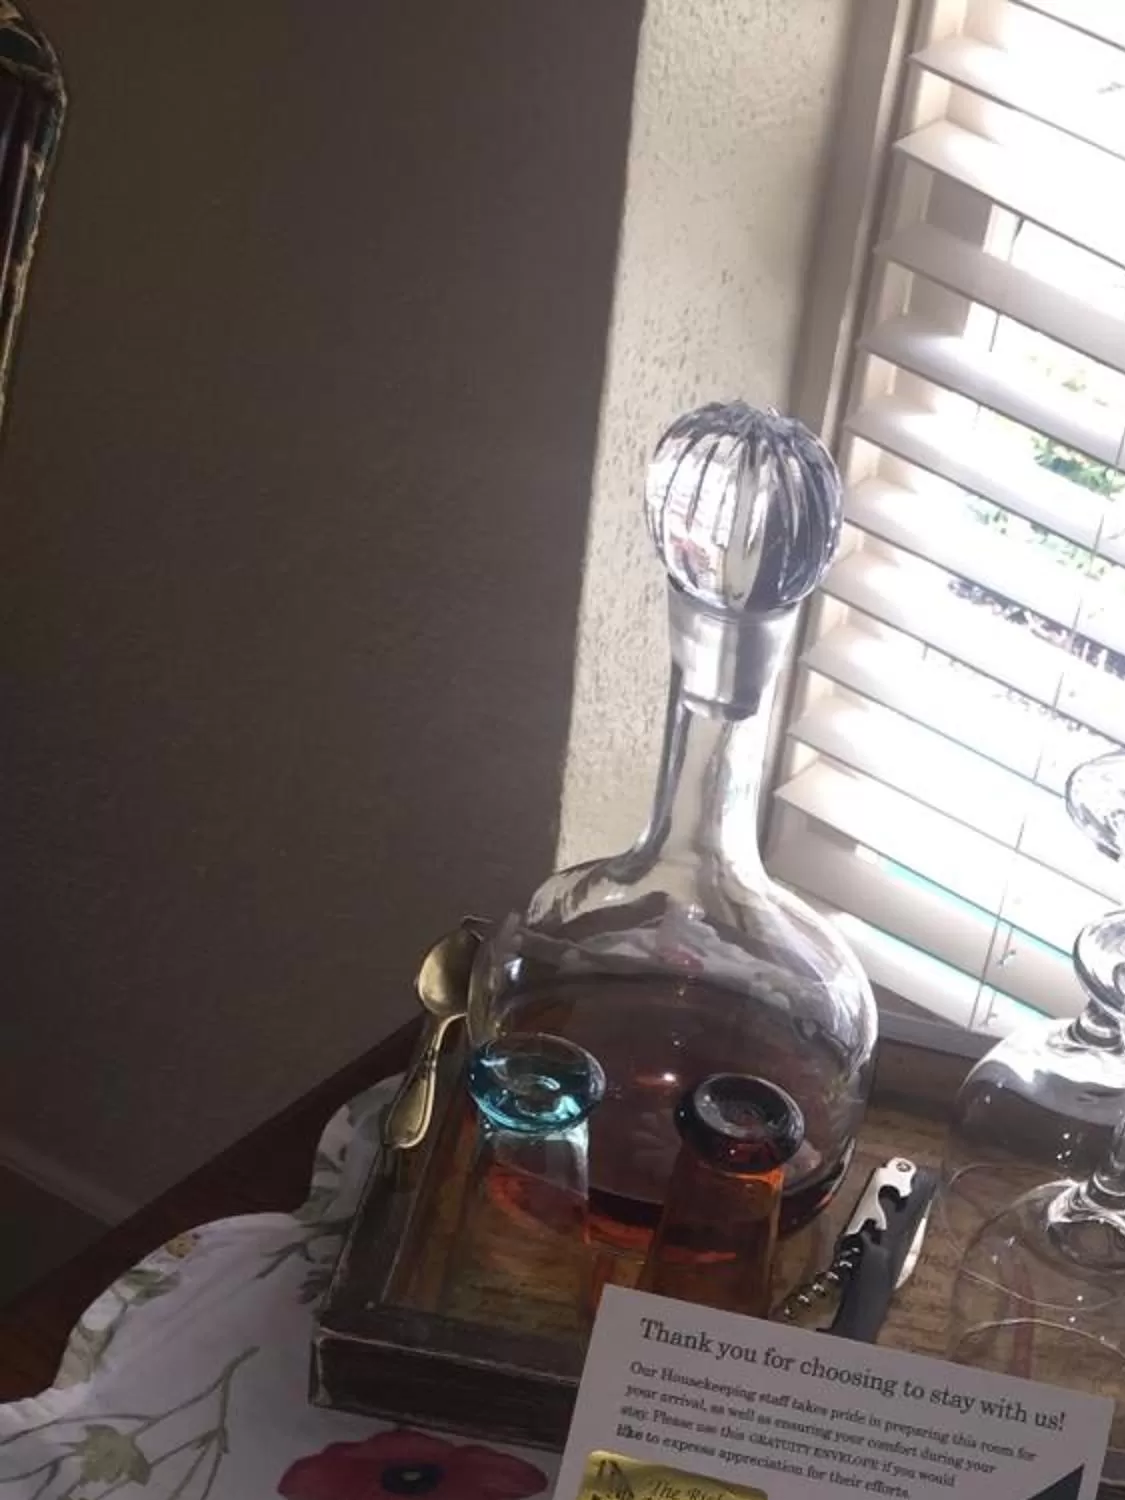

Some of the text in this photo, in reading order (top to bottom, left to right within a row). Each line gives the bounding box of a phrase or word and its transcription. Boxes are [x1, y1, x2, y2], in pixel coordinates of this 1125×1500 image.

[629, 1360, 1038, 1462] Our Housekeeping staff takes pride in preparing this room for
[639, 1317, 1067, 1432] Thank you for choosing to stay with us!
[616, 1423, 644, 1441] like
[645, 1431, 661, 1445] to
[662, 1437, 717, 1457] express
[717, 1449, 804, 1477] appreciation
[806, 1464, 828, 1481] for
[829, 1471, 864, 1489] their
[623, 1384, 997, 1474] your arrival, as well as ensuring your comfort during your
[652, 1408, 695, 1431] Please
[695, 1423, 718, 1435] use
[719, 1425, 745, 1441] this
[748, 1432, 813, 1457] GRATUITY
[812, 1447, 880, 1471] ENVELOPE
[881, 1461, 895, 1473] if
[890, 1465, 917, 1480] you
[918, 1471, 956, 1488] would
[649, 1479, 681, 1500] The
